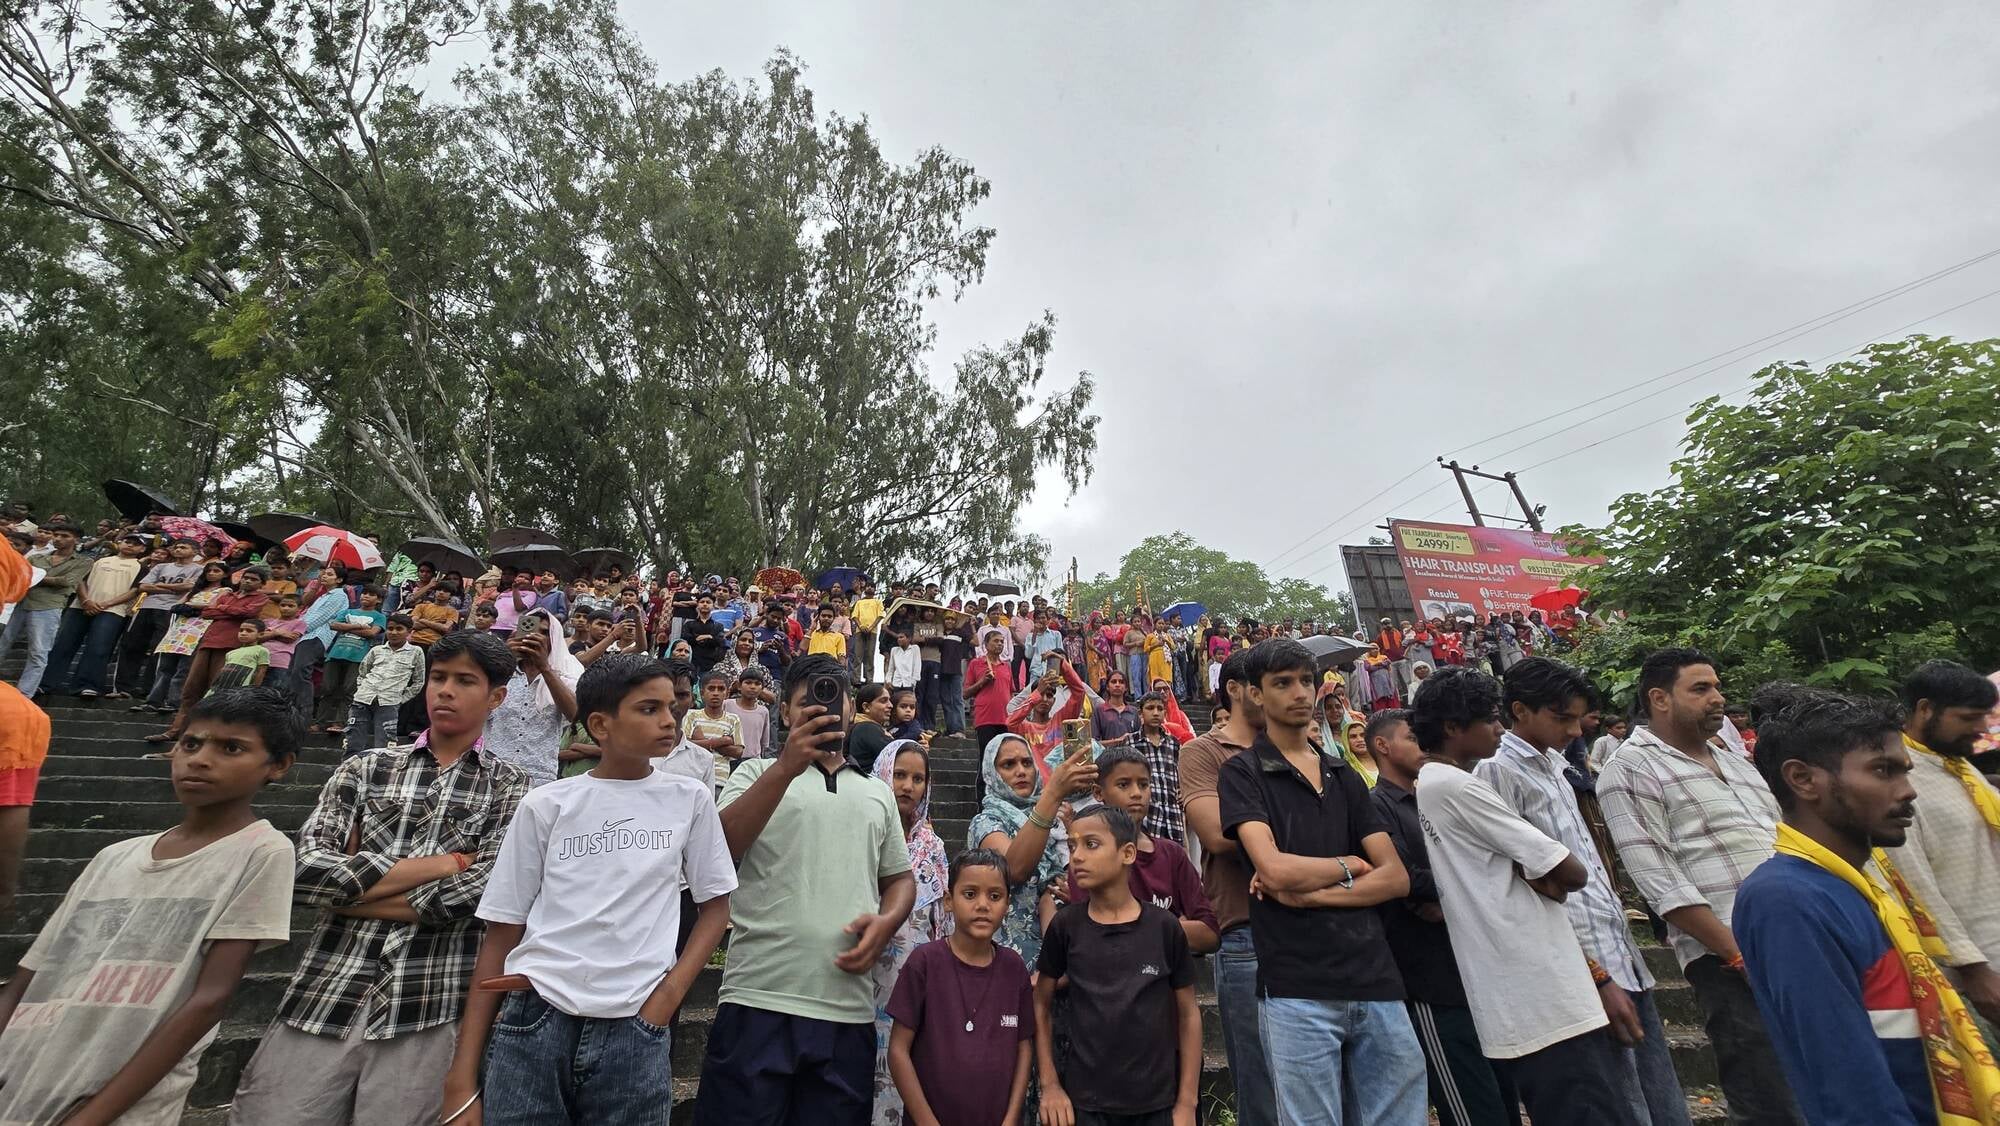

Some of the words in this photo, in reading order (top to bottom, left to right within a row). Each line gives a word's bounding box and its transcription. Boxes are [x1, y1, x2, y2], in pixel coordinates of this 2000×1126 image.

[1411, 556, 1439, 569] HAIR
[1440, 560, 1515, 575] TRANSPLANT
[1428, 587, 1460, 599] Results
[1489, 589, 1505, 598] FUE
[1493, 601, 1505, 610] Bio
[80, 964, 176, 1004] NEW
